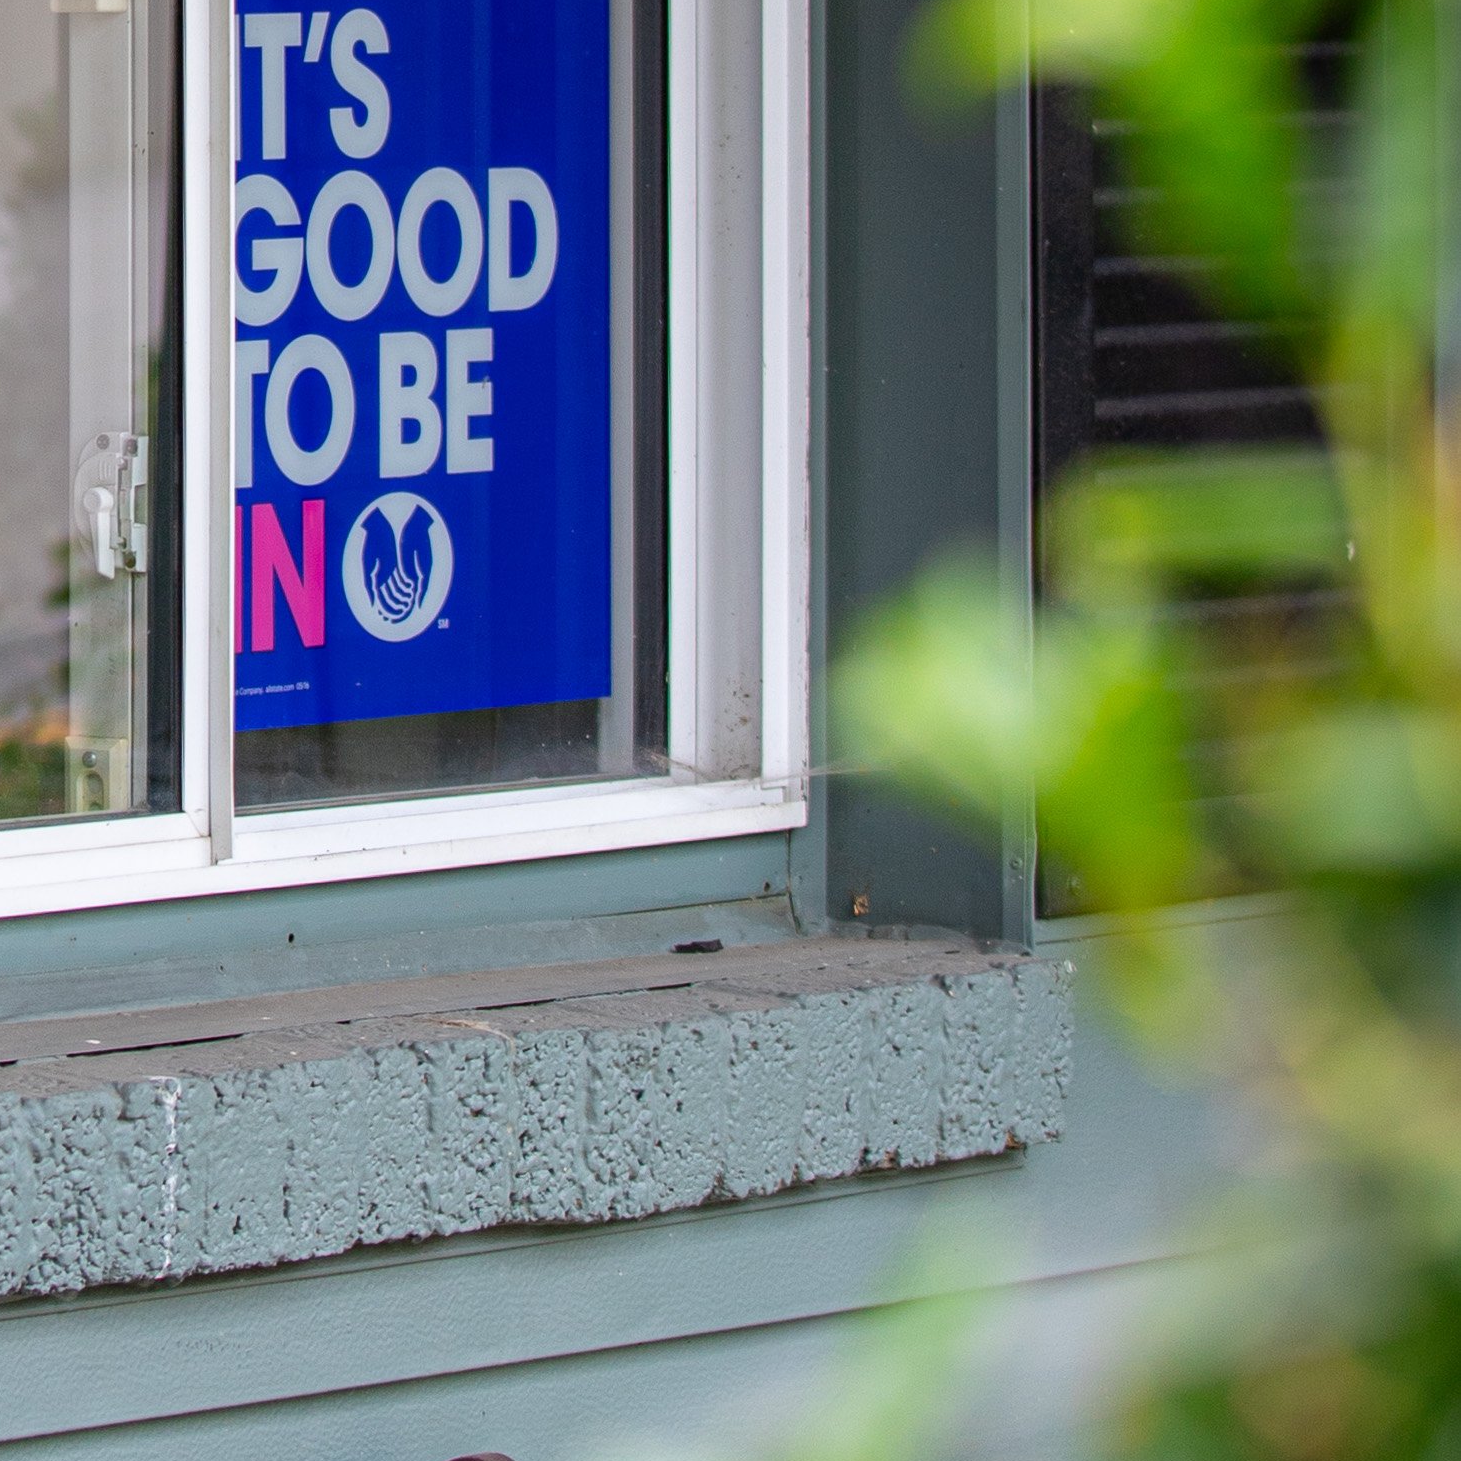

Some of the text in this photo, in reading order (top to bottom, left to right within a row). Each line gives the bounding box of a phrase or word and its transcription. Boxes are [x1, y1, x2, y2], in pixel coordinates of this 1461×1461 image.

[235, 7, 391, 161] T'S
[235, 166, 559, 326] GOOD
[379, 327, 494, 479] BE
